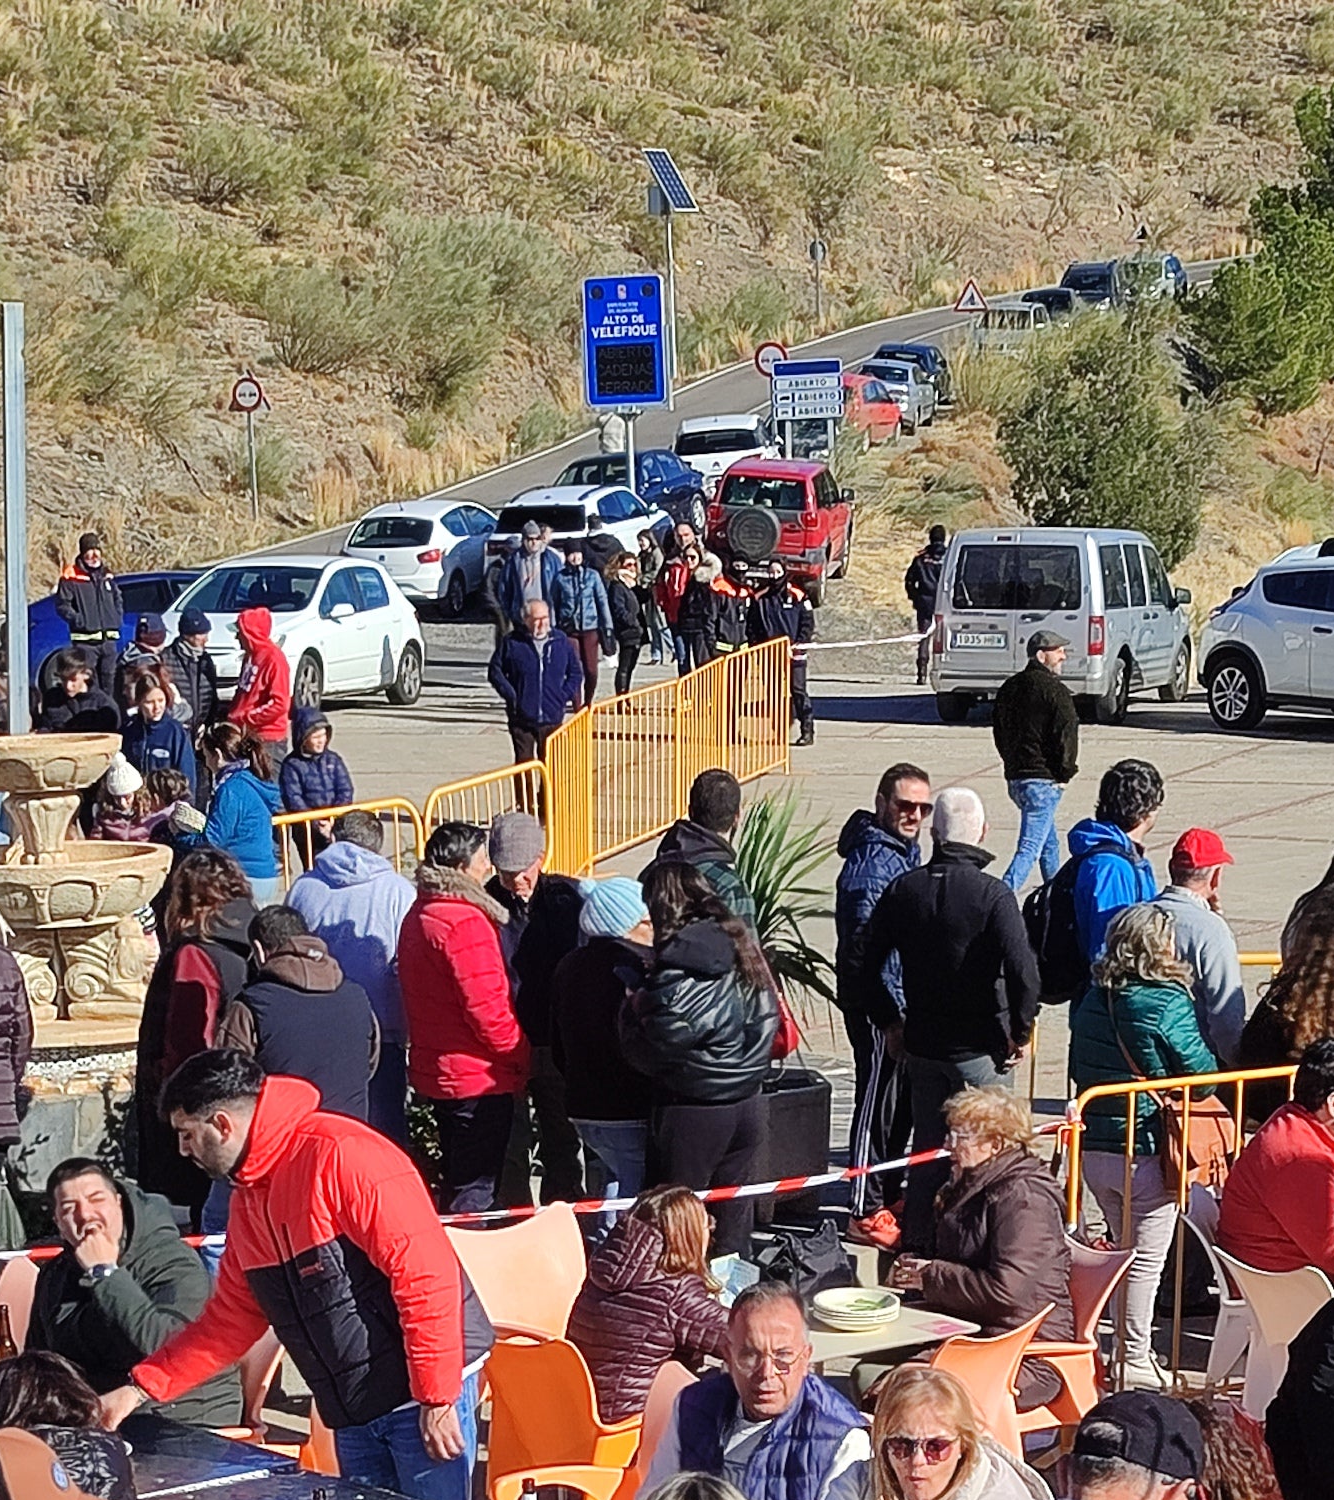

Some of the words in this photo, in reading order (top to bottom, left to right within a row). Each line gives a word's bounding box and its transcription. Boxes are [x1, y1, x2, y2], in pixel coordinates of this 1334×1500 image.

[602, 315, 628, 325] ALTO
[631, 314, 645, 323] DE
[591, 324, 657, 339] VELEFIQUE
[789, 378, 827, 388] ABIERTO
[798, 392, 836, 401] ABIERTO
[798, 406, 837, 415] ABIERTO
